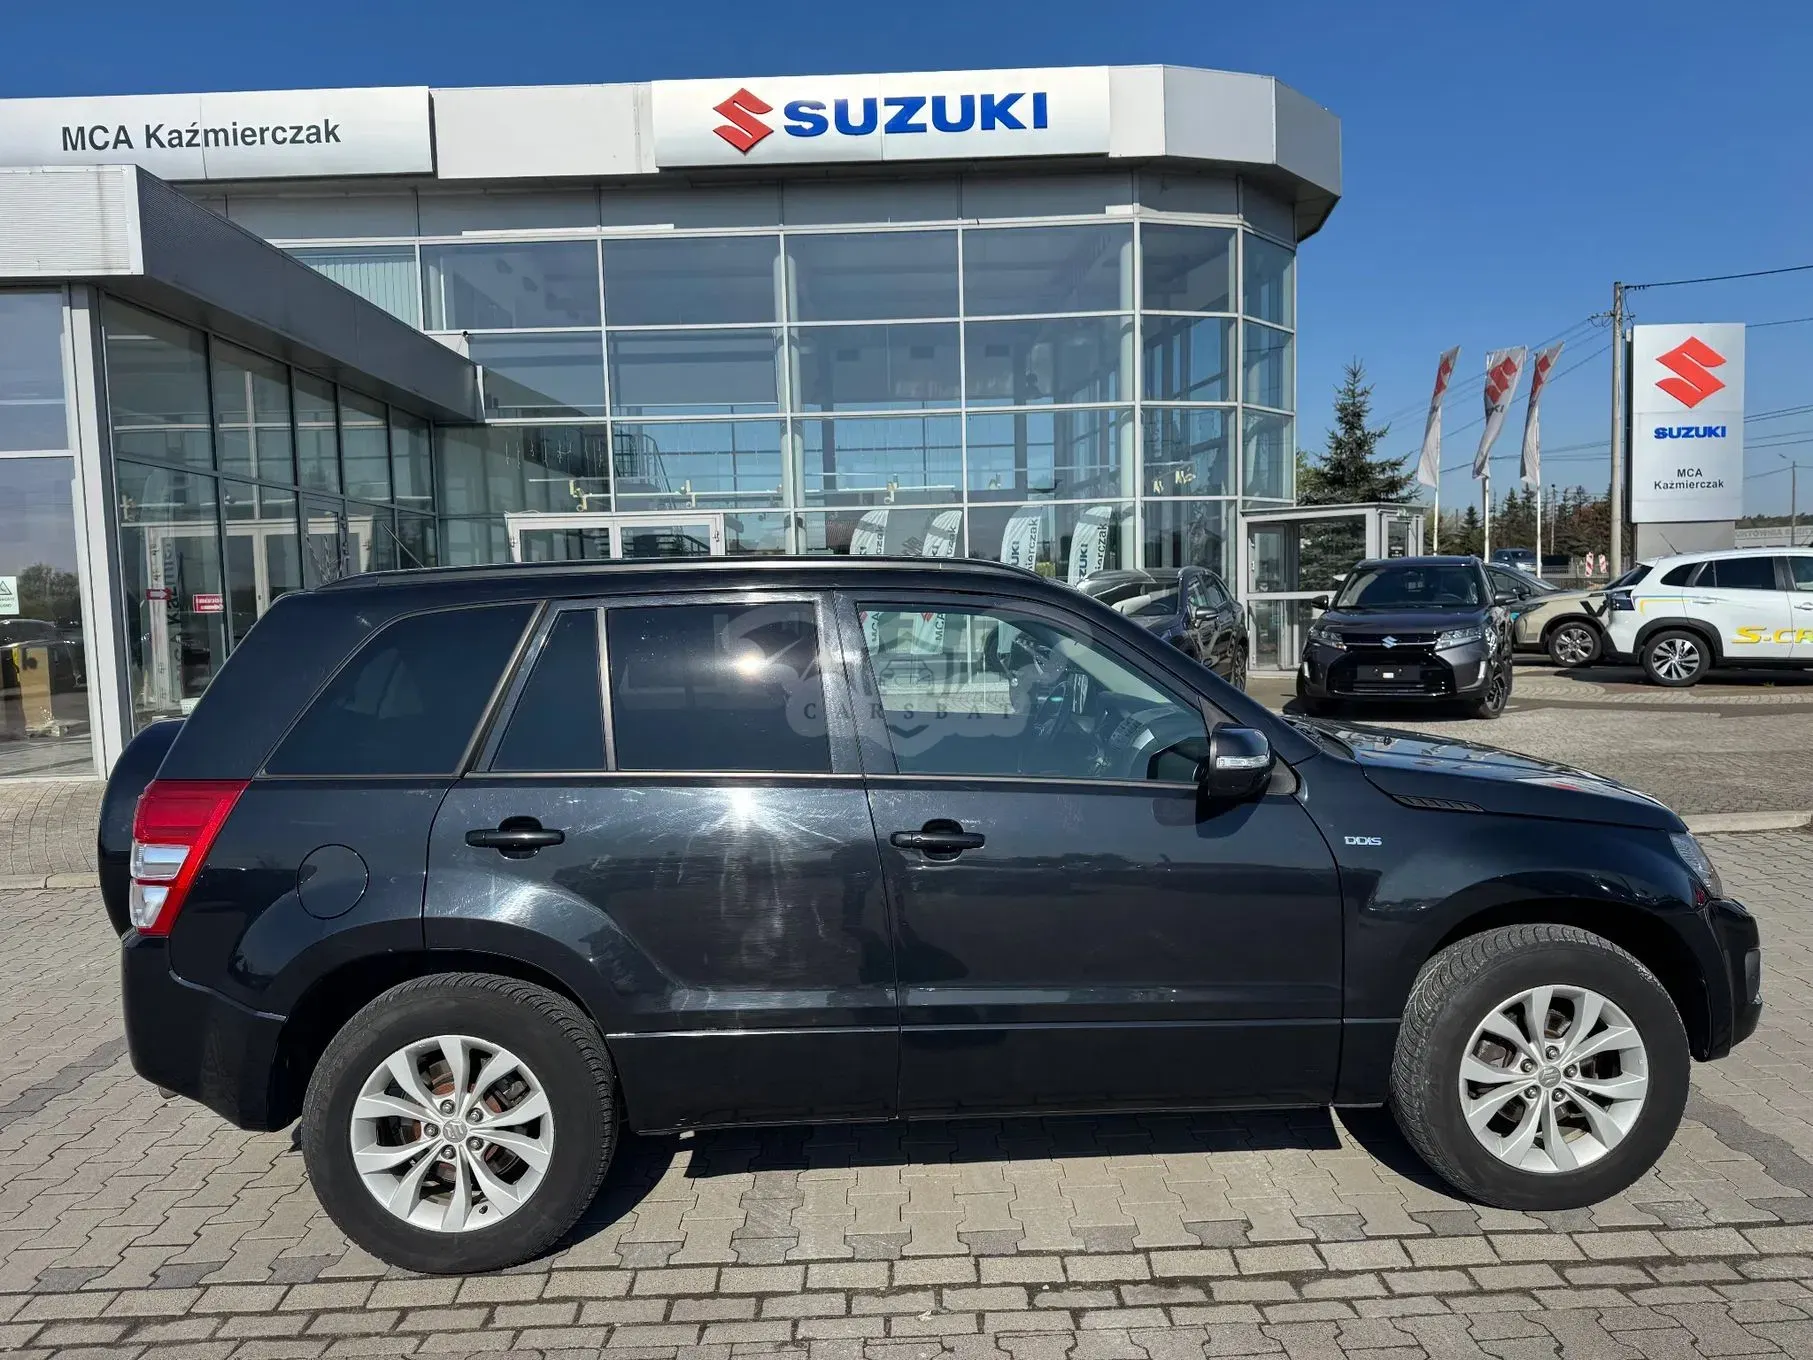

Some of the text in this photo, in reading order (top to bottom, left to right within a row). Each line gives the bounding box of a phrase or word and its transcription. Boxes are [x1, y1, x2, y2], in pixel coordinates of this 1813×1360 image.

[783, 91, 1048, 137] SUZUKI
[61, 118, 342, 151] MCA Kaźmierczak
[1654, 426, 1727, 439] SUZUKI
[1677, 468, 1703, 477] MCA
[1025, 518, 1038, 568] ierczak
[1079, 543, 1088, 579] ZUKI
